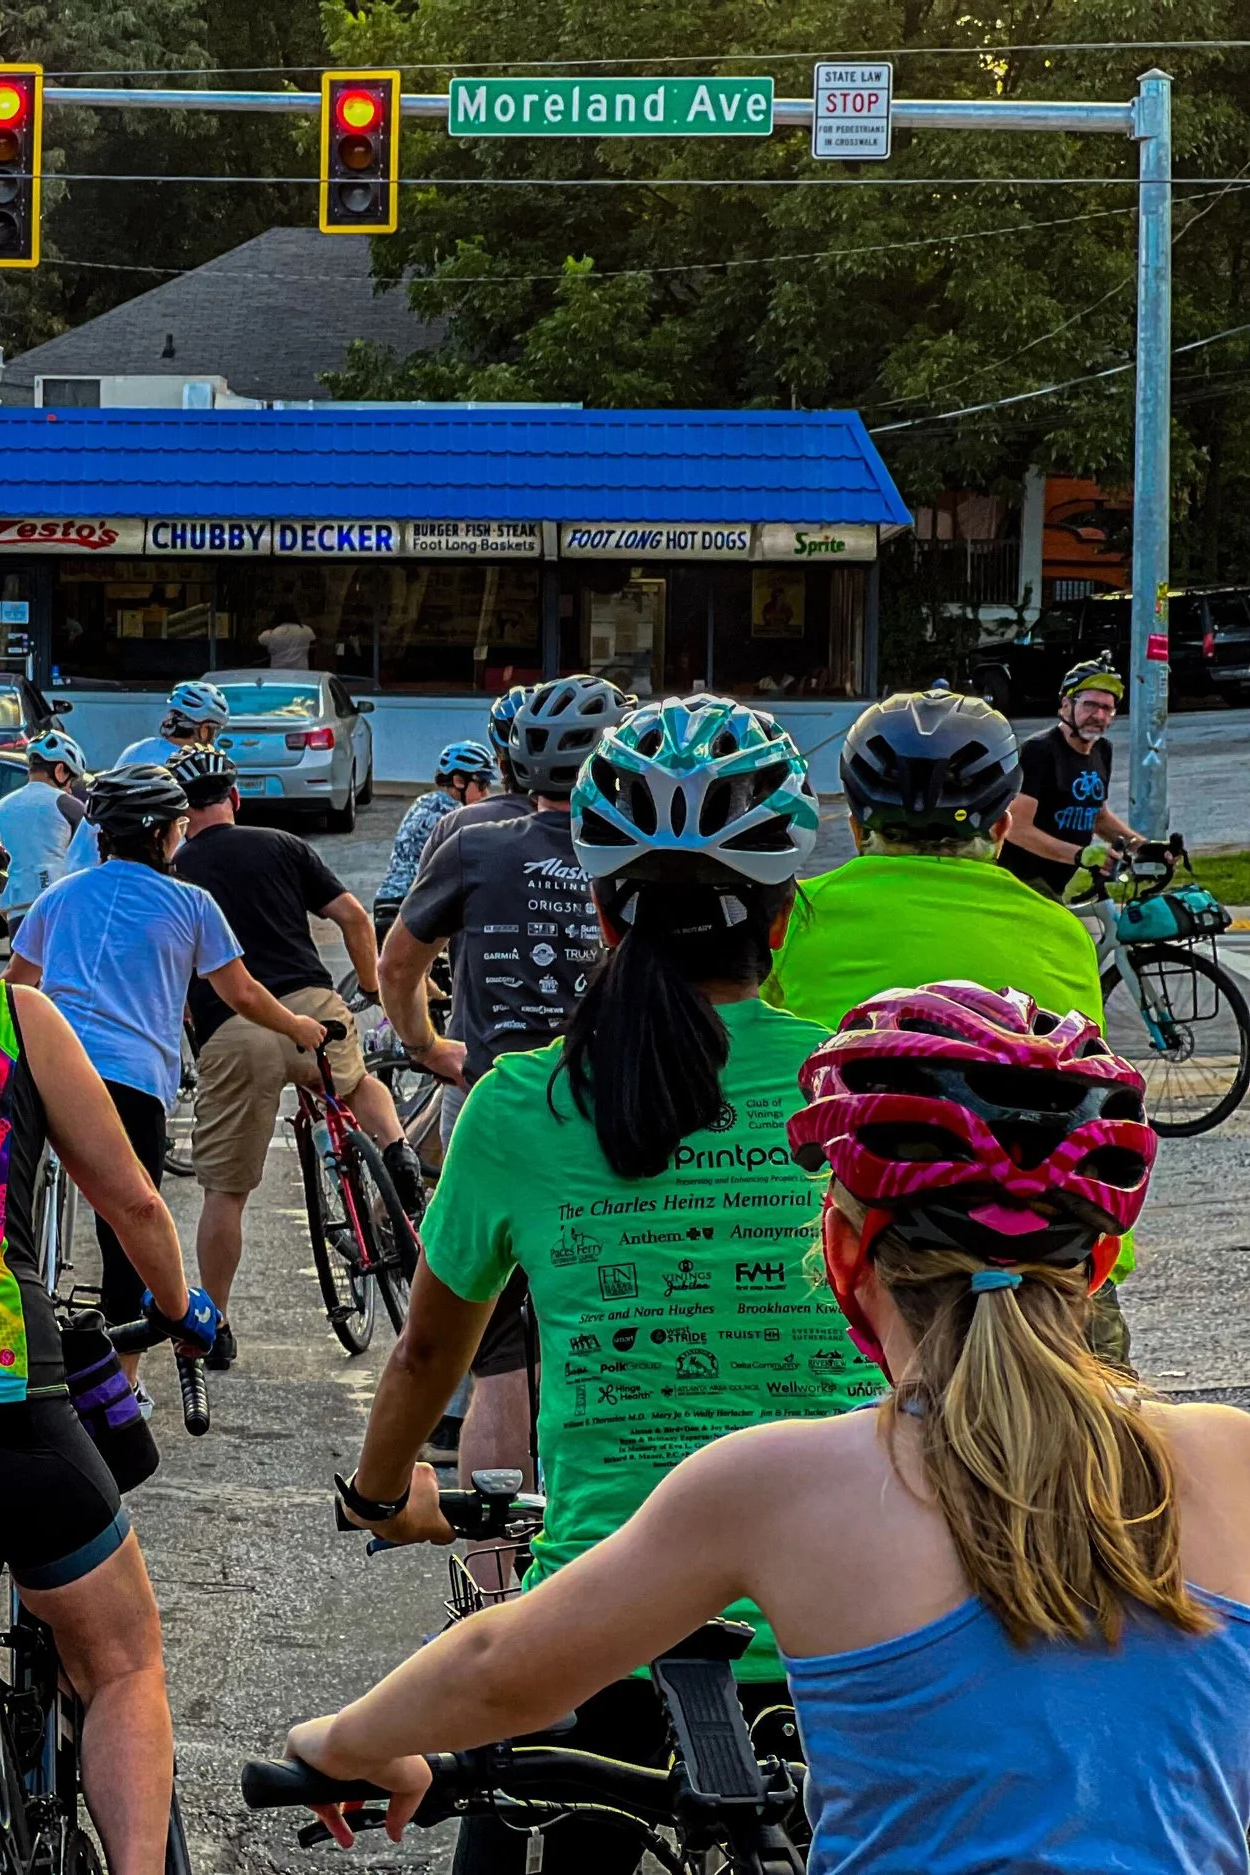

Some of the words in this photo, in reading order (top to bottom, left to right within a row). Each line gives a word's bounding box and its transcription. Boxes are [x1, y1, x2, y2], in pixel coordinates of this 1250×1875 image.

[825, 71, 856, 82] STATE
[861, 71, 882, 82] LAW
[457, 85, 665, 122] Moreland
[686, 84, 767, 122] Ave
[826, 93, 879, 113] STOP
[818, 125, 833, 133] FOR
[836, 125, 885, 133] PEDESTRIANS
[825, 138, 832, 146] IN
[835, 138, 878, 146] CROSSWALK
[152, 522, 265, 550] CHUBBY
[413, 523, 459, 537] BURGER
[466, 523, 491, 537] FISH
[497, 524, 537, 537] STEAK
[279, 524, 393, 552] DECKER
[567, 529, 615, 549] FOOT
[615, 529, 662, 549] LONG
[666, 530, 698, 550] HOT
[701, 531, 747, 551] DOGS
[793, 532, 846, 556] Sprite
[413, 539, 442, 551] Foot
[528, 900, 582, 914] ORIG3N
[484, 951, 519, 960] GARMIN
[565, 948, 598, 959] TRULY
[747, 1099, 768, 1108] Club
[771, 1099, 782, 1108] of
[747, 1110, 784, 1119] Vinings
[674, 1144, 792, 1172] Printpa
[558, 1202, 584, 1221] The
[590, 1196, 657, 1216] Charles
[664, 1193, 715, 1211] Heinz
[723, 1190, 811, 1208] Memorial
[577, 1242, 603, 1257] Ferry
[662, 1271, 712, 1282] VININGS
[579, 1312, 605, 1323] Steve
[608, 1308, 630, 1321] and
[634, 1306, 665, 1318] Nora
[669, 1303, 715, 1317] Hughes
[737, 1302, 811, 1314] Brookhaven
[667, 1333, 707, 1344] STRIDE
[718, 1330, 761, 1340] TRUIST
[615, 1384, 641, 1393] Hinge
[677, 1385, 707, 1393] ATLANTA
[620, 1391, 651, 1400] Health
